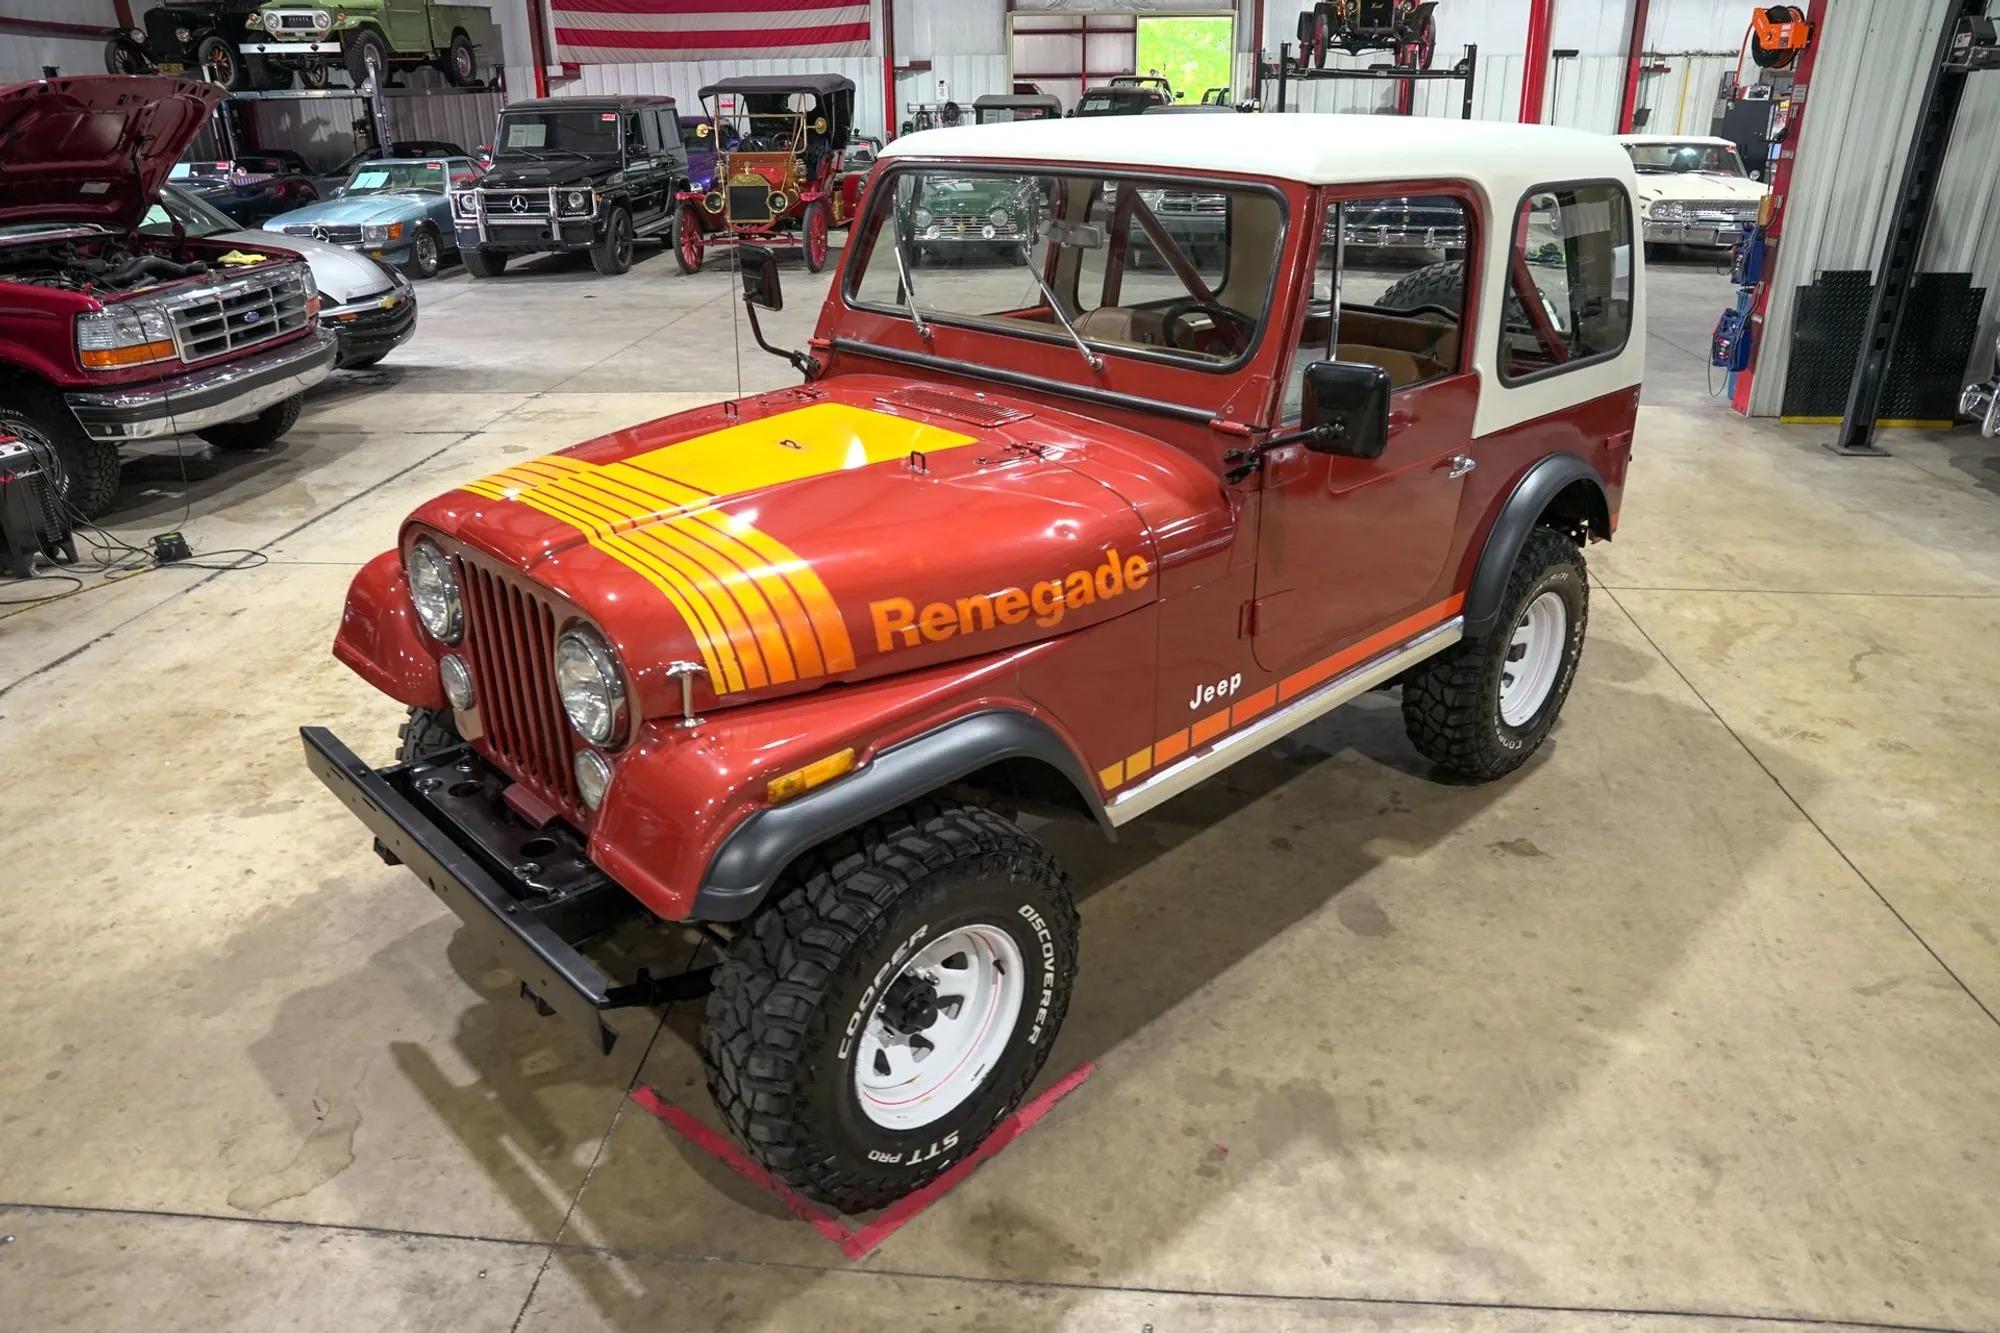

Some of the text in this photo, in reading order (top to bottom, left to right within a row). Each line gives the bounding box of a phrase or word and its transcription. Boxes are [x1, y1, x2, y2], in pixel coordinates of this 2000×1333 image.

[869, 549, 1150, 651] Renegade
[1189, 671, 1242, 711] Jeep
[837, 923, 929, 1061] COOPER
[1018, 904, 1057, 1045] DISCOVERER
[867, 1129, 960, 1167] STT PRO
